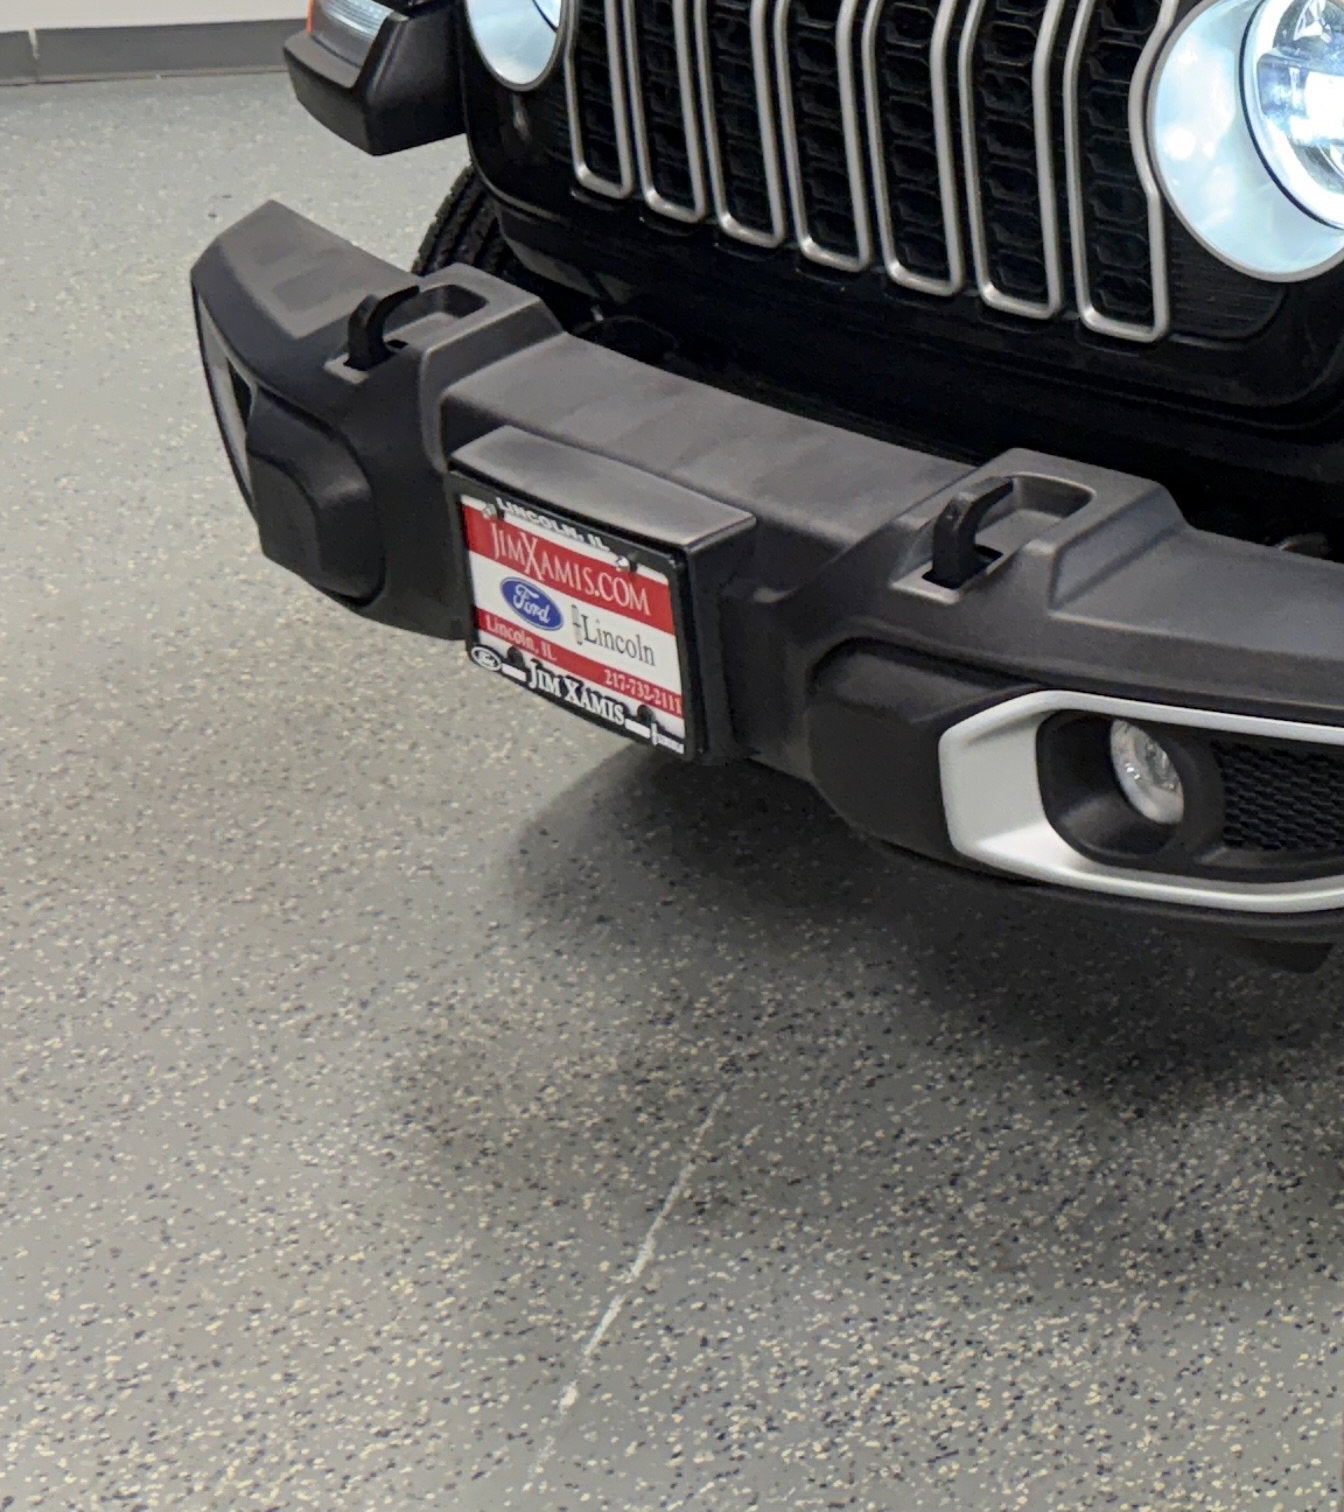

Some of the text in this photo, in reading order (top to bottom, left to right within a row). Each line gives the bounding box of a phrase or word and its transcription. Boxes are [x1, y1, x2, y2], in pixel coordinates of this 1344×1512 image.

[490, 522, 652, 617] JIMXAMIS.COM
[512, 583, 552, 625] Ford
[485, 614, 557, 662] Lincoln, IL
[579, 613, 656, 667] Lincoln
[528, 660, 626, 726] JIM XAMIS
